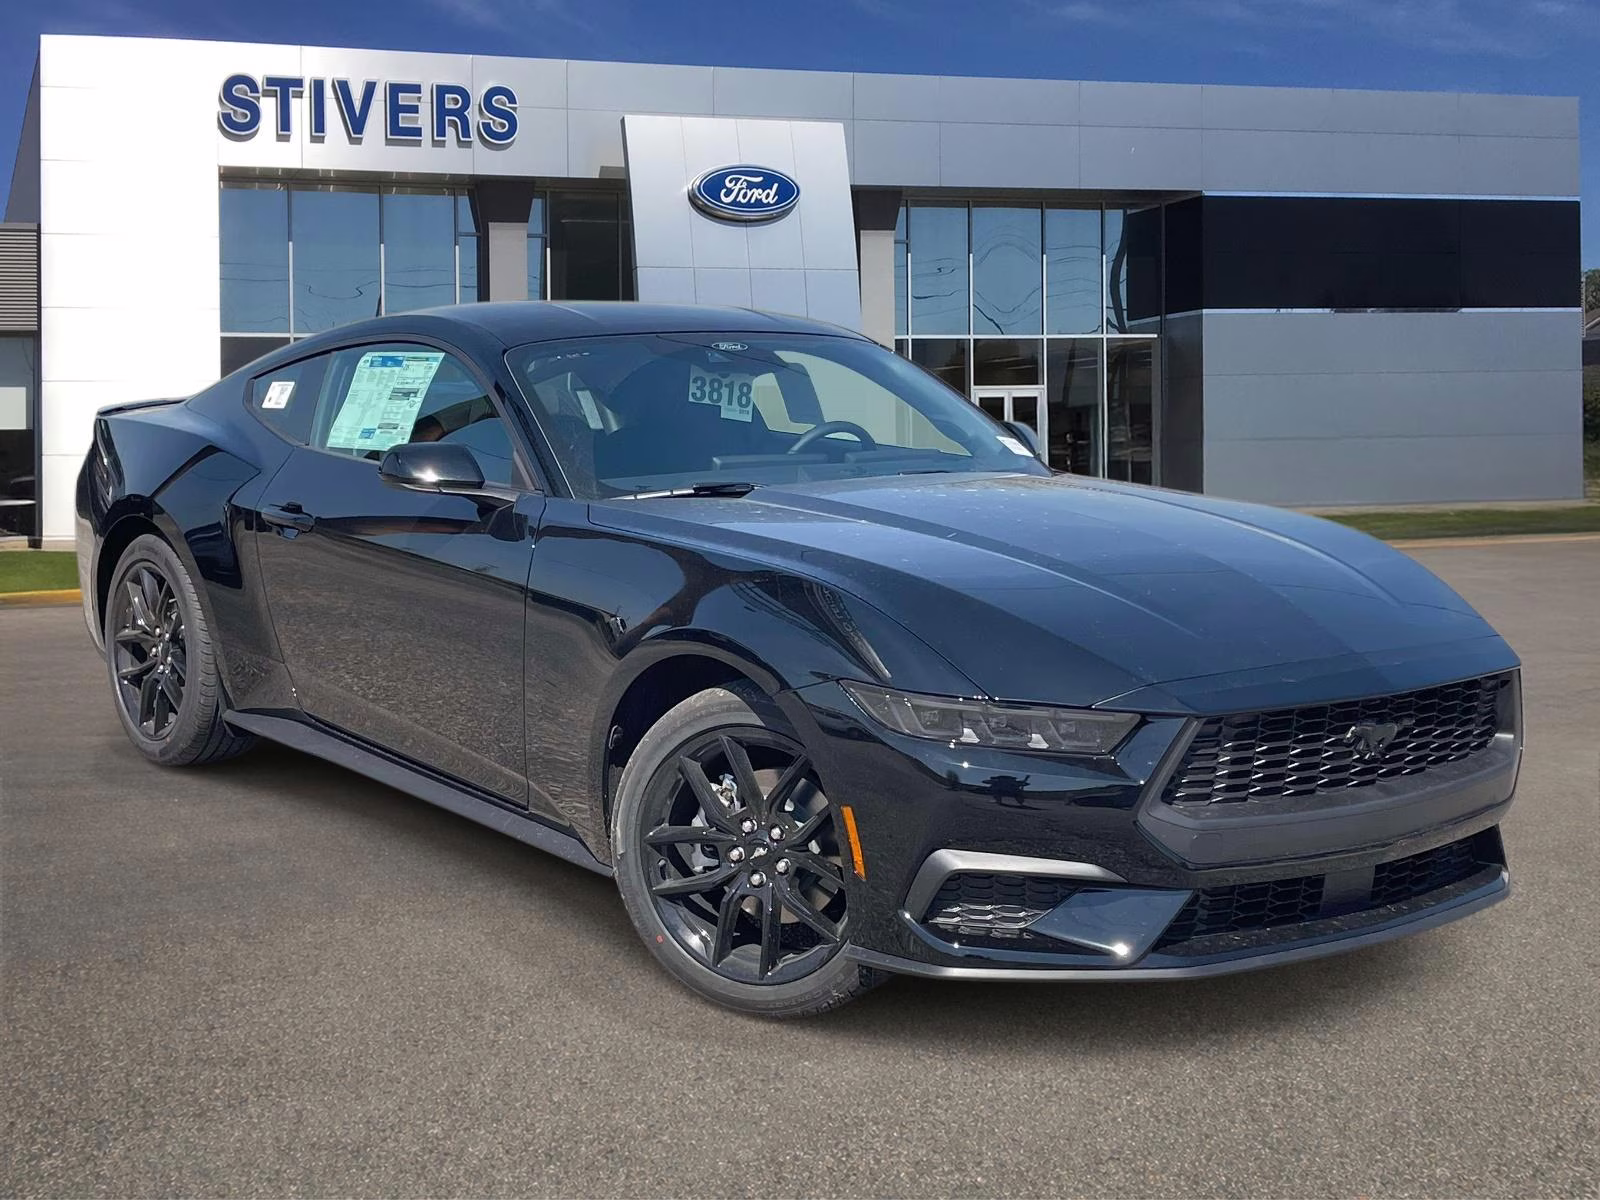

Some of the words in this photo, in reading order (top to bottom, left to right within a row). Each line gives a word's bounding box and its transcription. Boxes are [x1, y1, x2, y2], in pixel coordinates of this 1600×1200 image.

[218, 74, 519, 145] STIVERS
[720, 174, 779, 205] Ford
[718, 343, 742, 351] Ford
[691, 376, 752, 408] 3818
